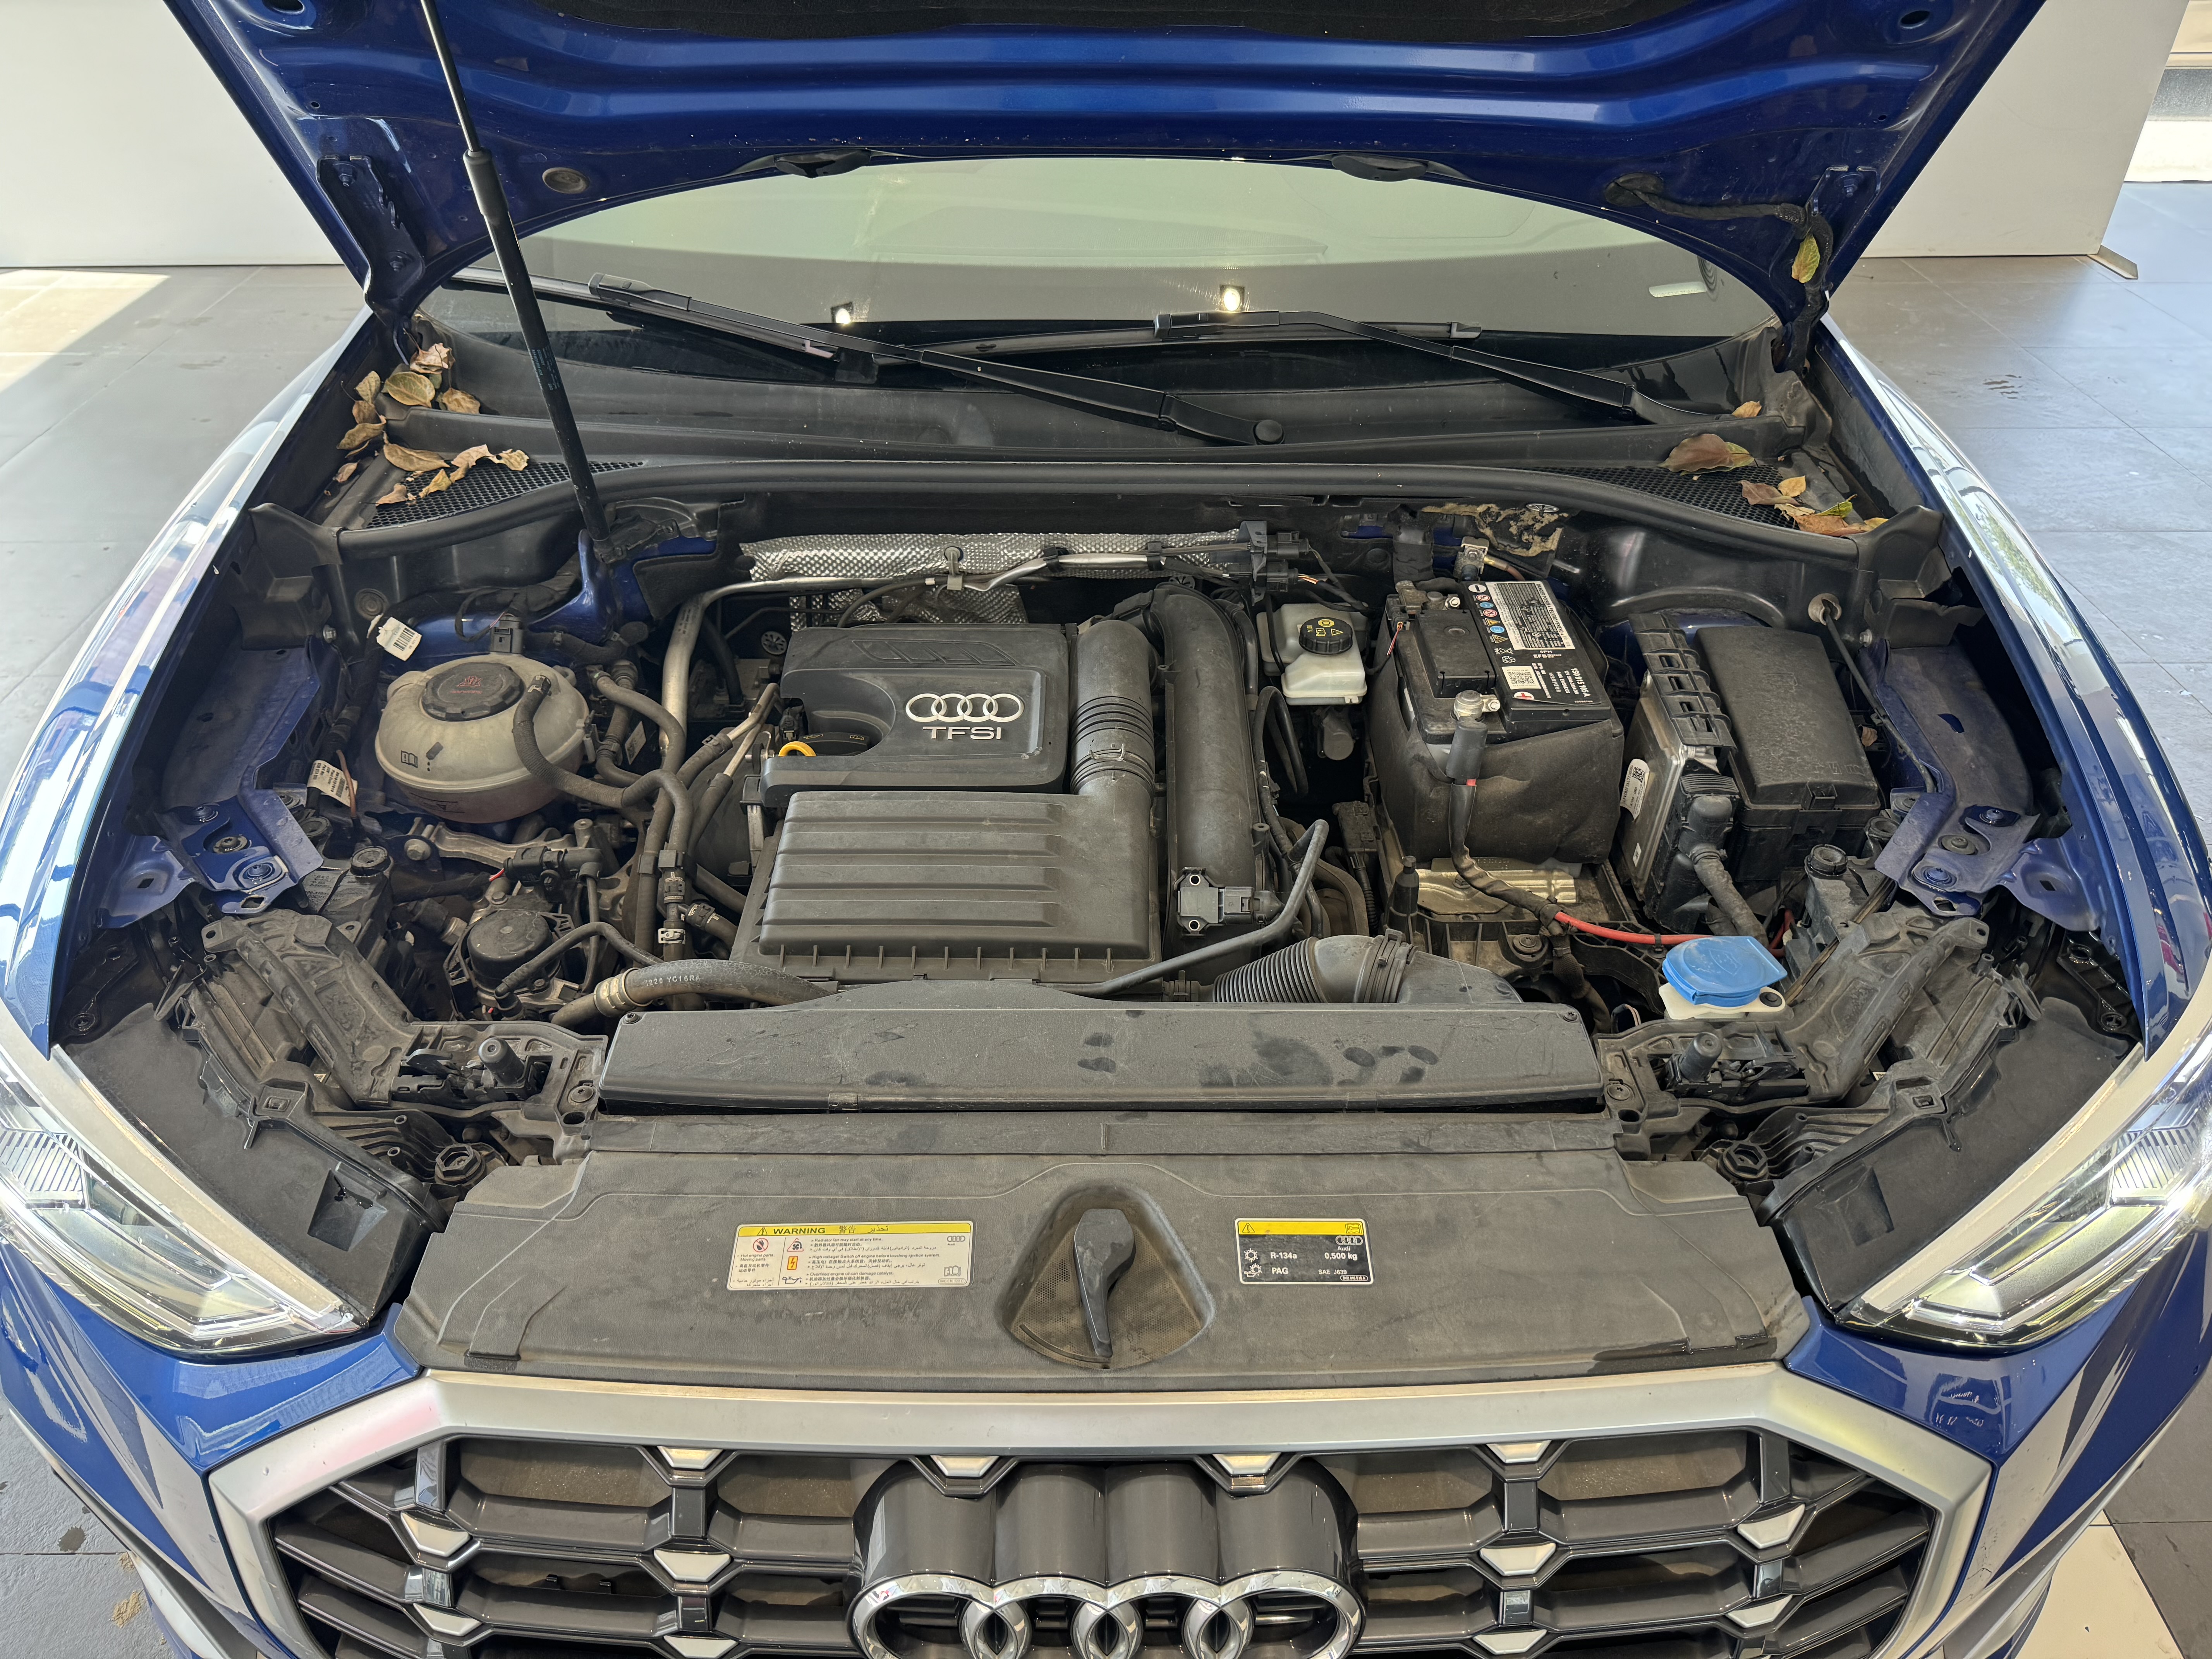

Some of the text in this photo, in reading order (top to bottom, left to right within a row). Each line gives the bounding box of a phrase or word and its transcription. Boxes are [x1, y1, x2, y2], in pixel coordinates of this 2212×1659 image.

[923, 726, 1001, 740] TFSI
[839, 1225, 856, 1234] 警告
[868, 1225, 889, 1233] تحذير
[1348, 1252, 1358, 1261] kg
